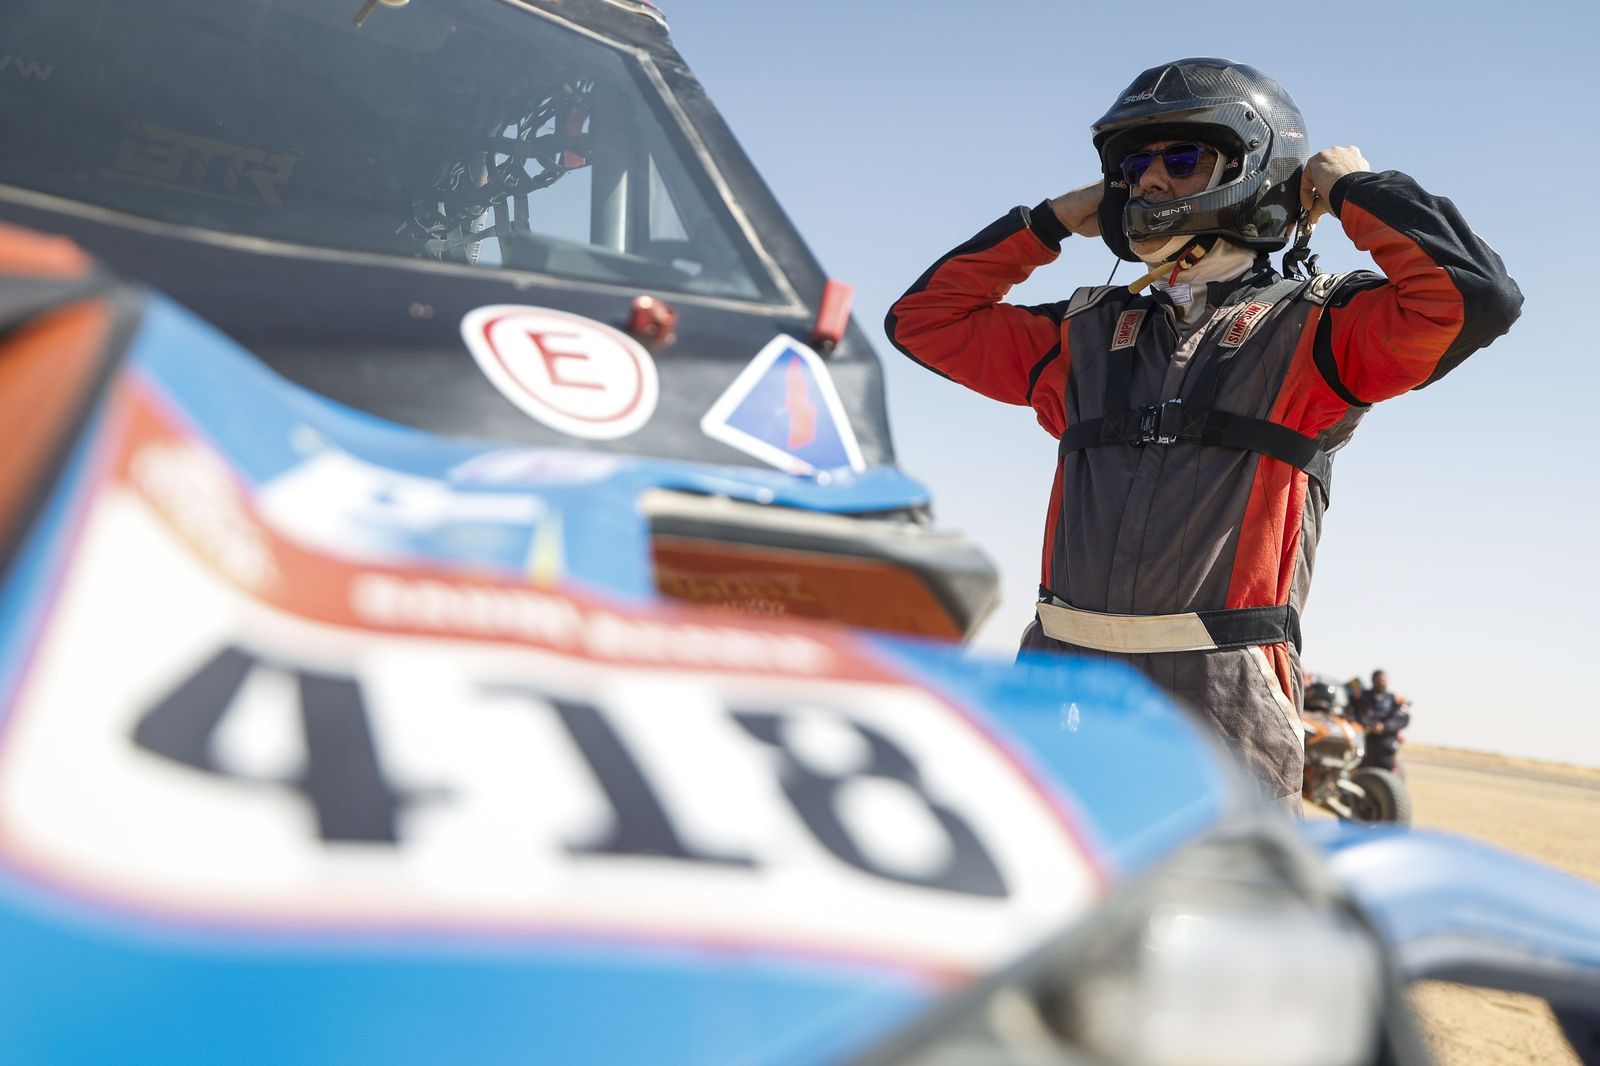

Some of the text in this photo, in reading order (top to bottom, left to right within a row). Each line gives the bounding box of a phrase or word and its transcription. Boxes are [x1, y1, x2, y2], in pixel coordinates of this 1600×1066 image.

[1117, 311, 1138, 345] SIMPSON
[1228, 303, 1263, 344] SIMPSON
[525, 330, 606, 392] E
[128, 643, 1012, 900] 418
